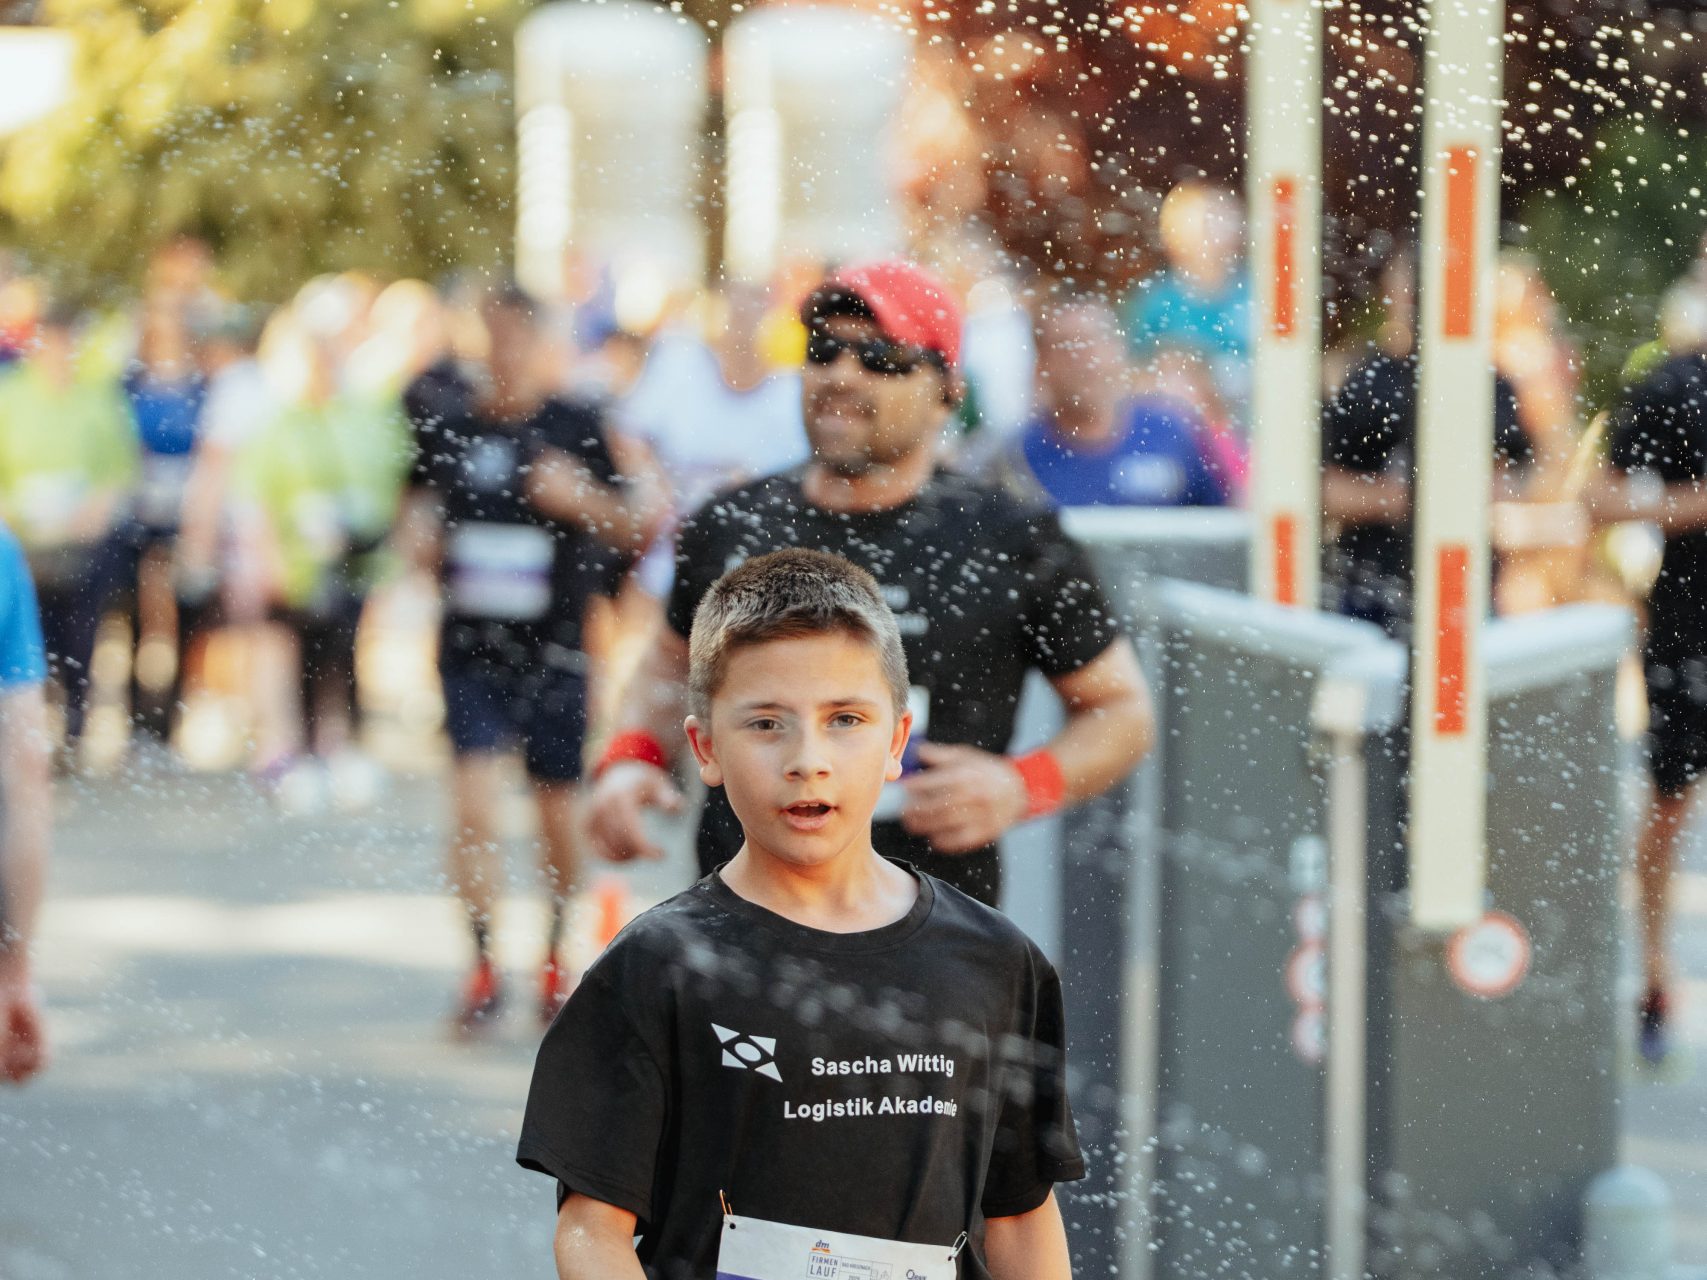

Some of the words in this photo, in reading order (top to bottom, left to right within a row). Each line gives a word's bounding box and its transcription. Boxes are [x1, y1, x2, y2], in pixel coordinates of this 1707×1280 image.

[811, 1056, 892, 1076] Sascha
[897, 1054, 955, 1077] Wittig
[783, 1098, 874, 1122] Logistik
[877, 1096, 958, 1118] Akademie
[815, 1239, 830, 1249] dm
[811, 1256, 839, 1266] FIRMEN
[809, 1265, 837, 1278] LAUF
